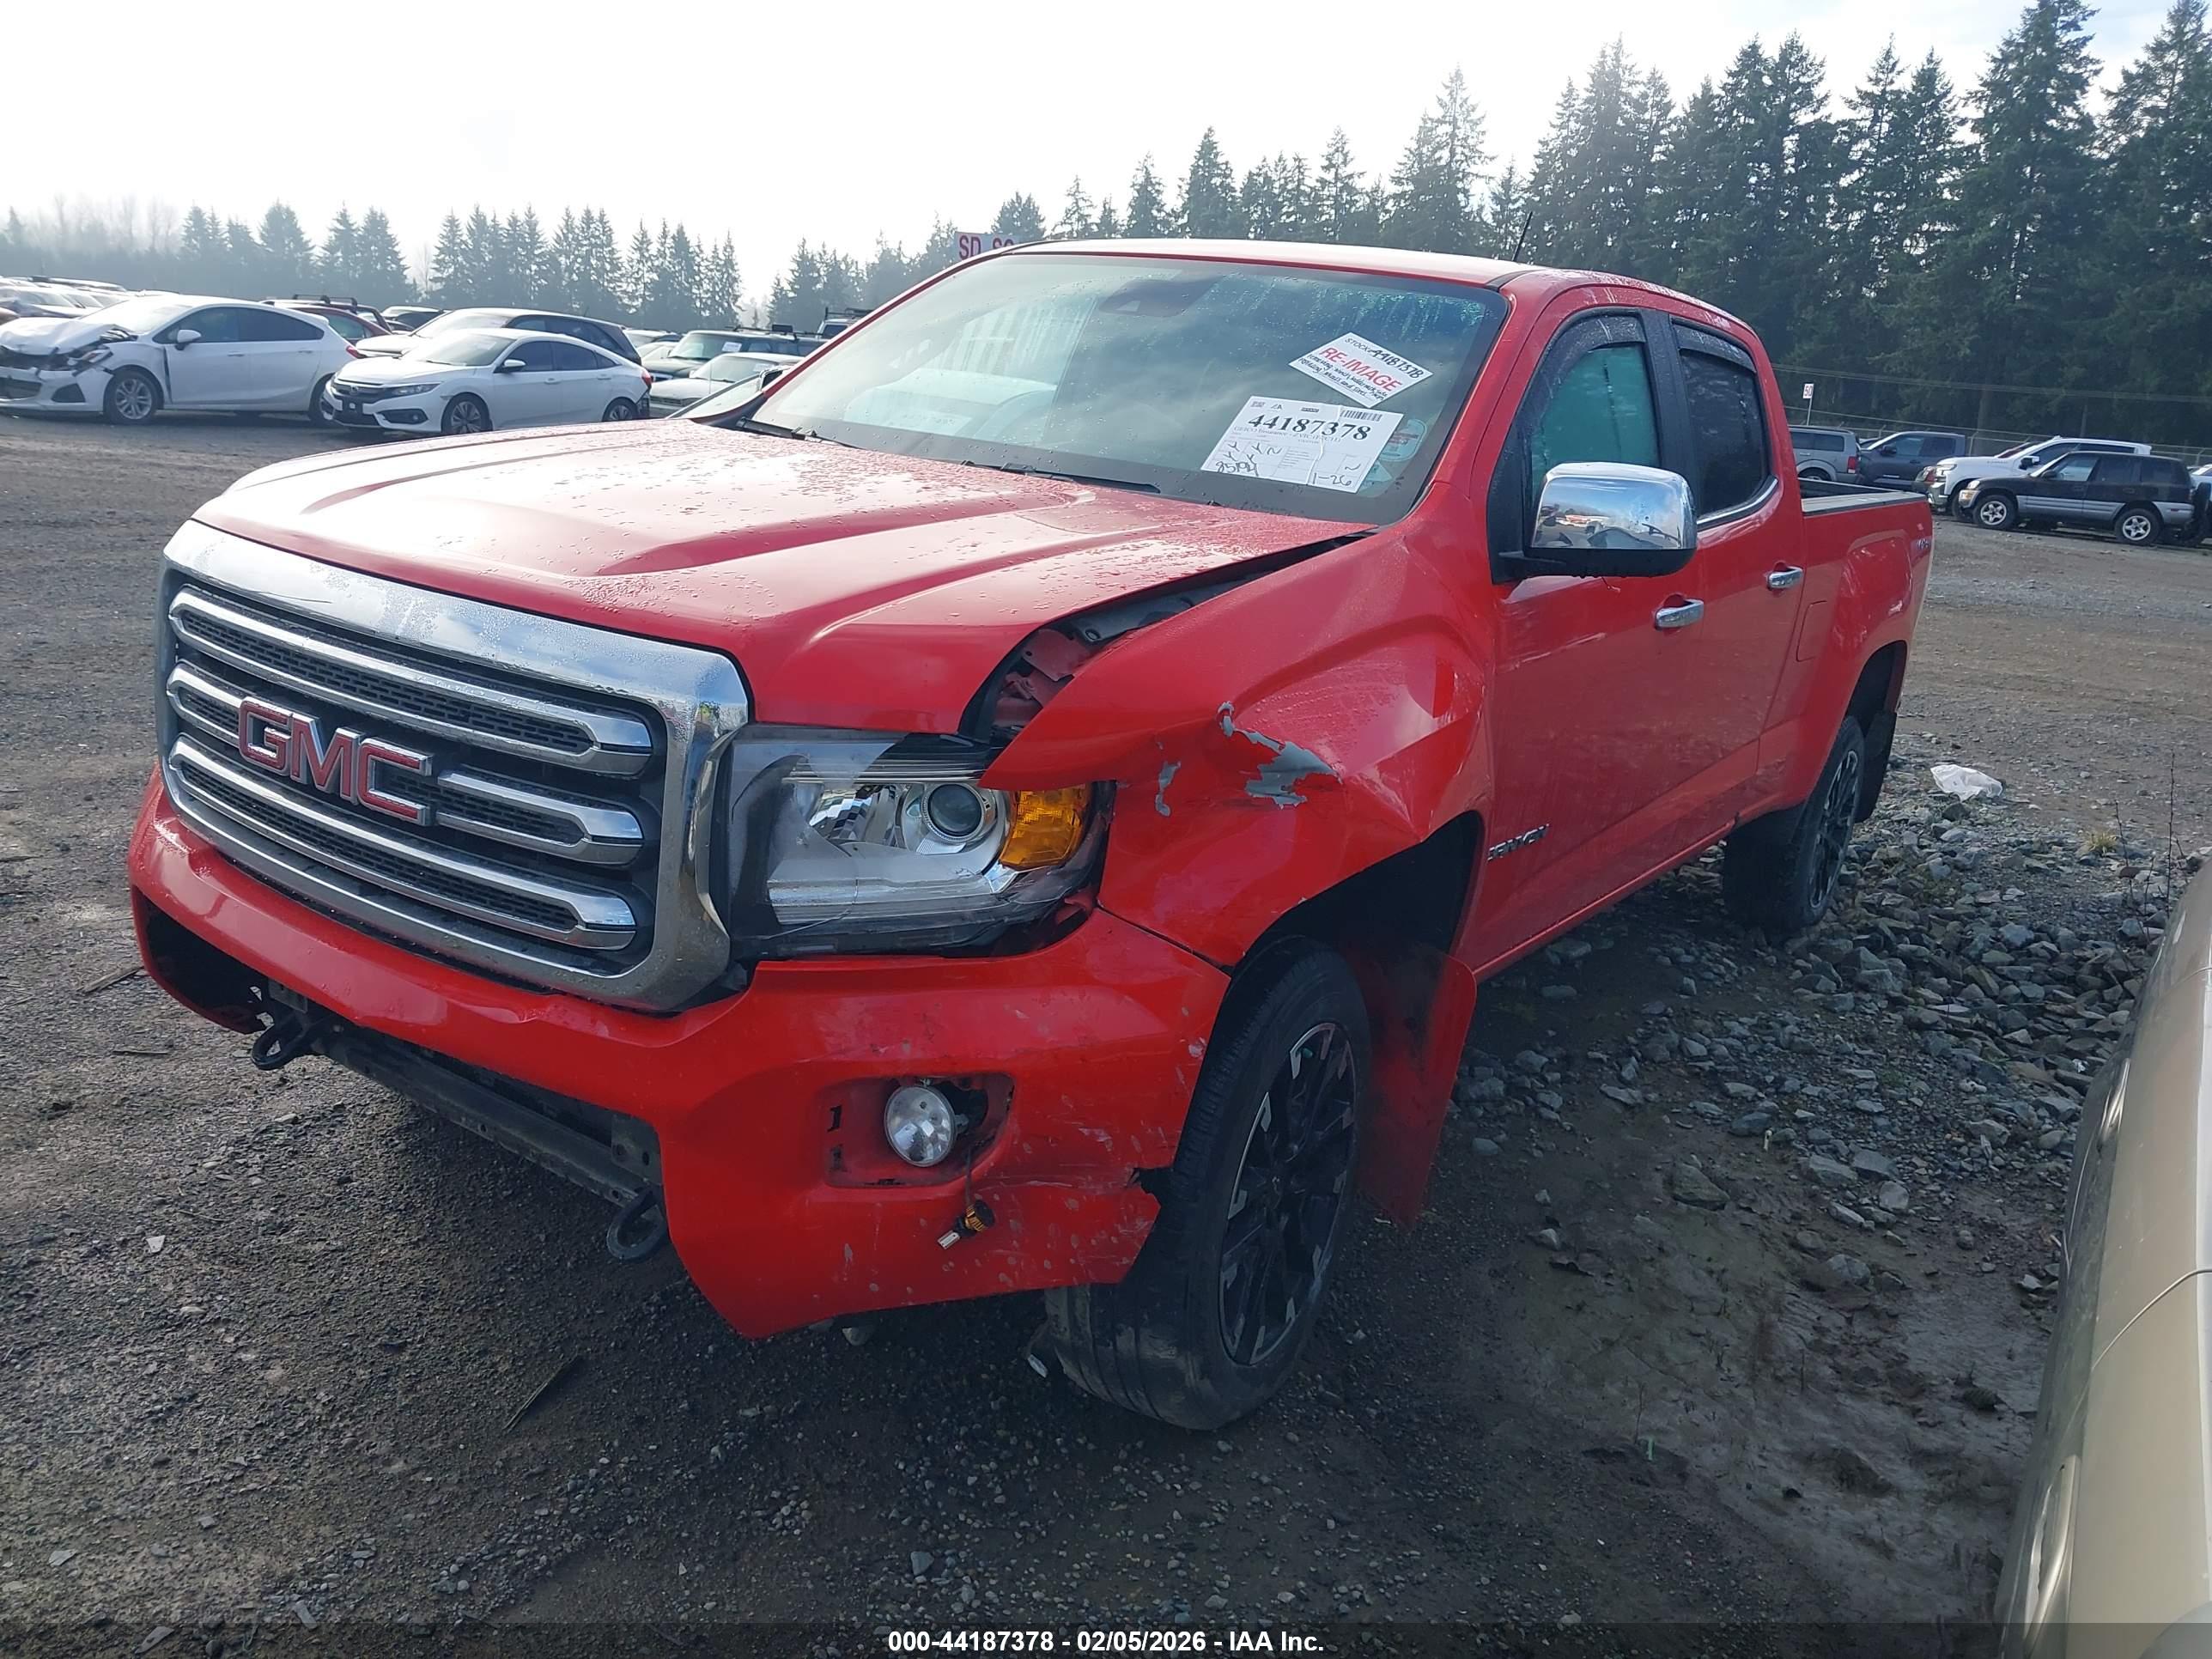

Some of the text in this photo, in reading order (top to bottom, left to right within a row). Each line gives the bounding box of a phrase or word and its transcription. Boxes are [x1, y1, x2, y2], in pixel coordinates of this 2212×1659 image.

[1319, 347, 1402, 392] RE-IMAGE
[1248, 414, 1371, 441] 44187378
[239, 696, 434, 827] GMC
